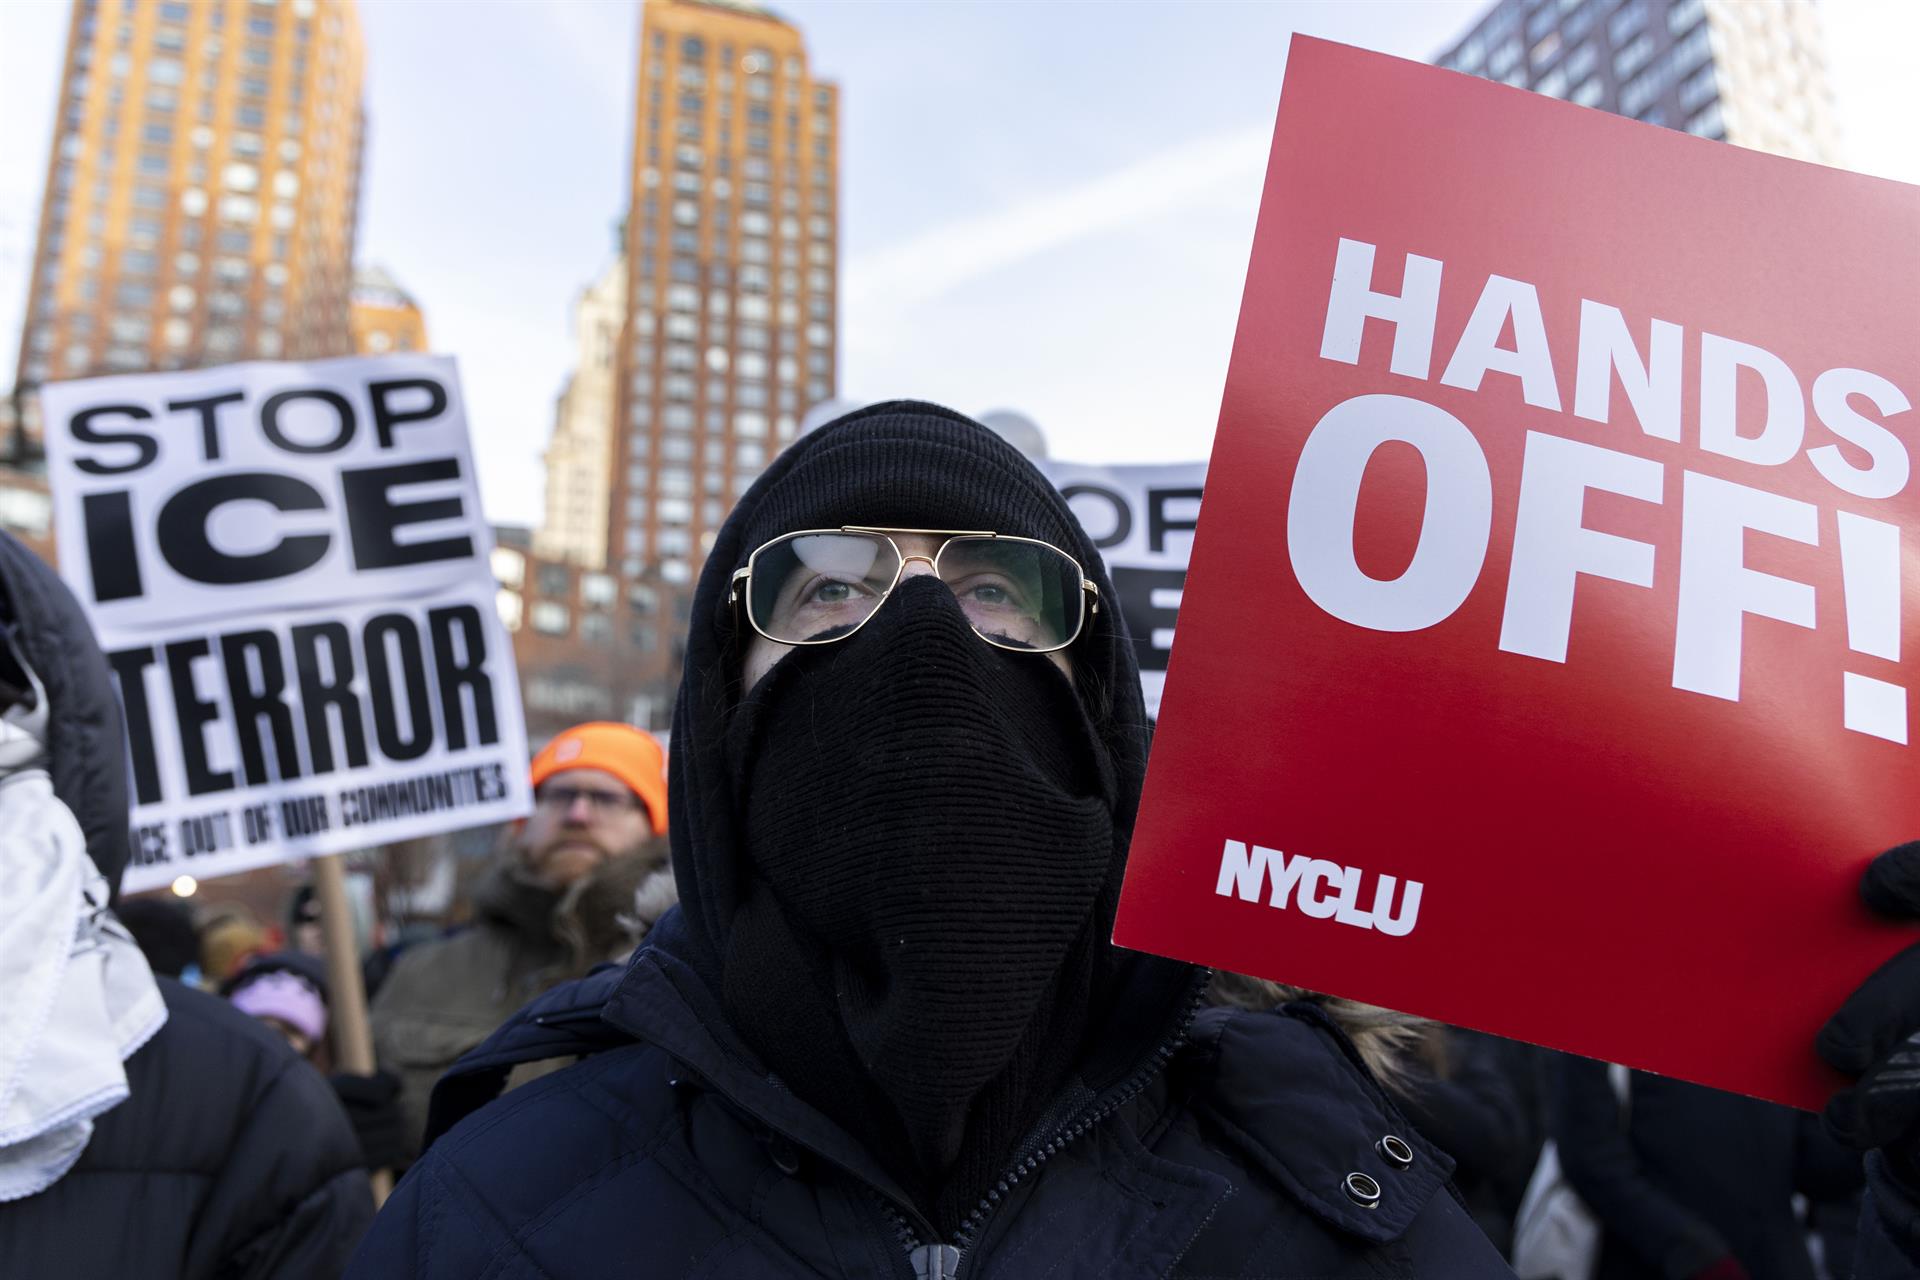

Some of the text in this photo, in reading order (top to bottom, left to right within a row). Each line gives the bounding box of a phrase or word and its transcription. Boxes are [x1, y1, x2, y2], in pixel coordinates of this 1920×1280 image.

[69, 378, 448, 475] STOP
[1319, 237, 1912, 499] HANDS
[82, 458, 475, 602] ICE
[1287, 393, 1908, 745] OFF!
[108, 604, 499, 806] TERROR
[130, 763, 506, 867] ICE OUT OF OUR COMMUNITIES
[1215, 839, 1424, 937] NYCLU
